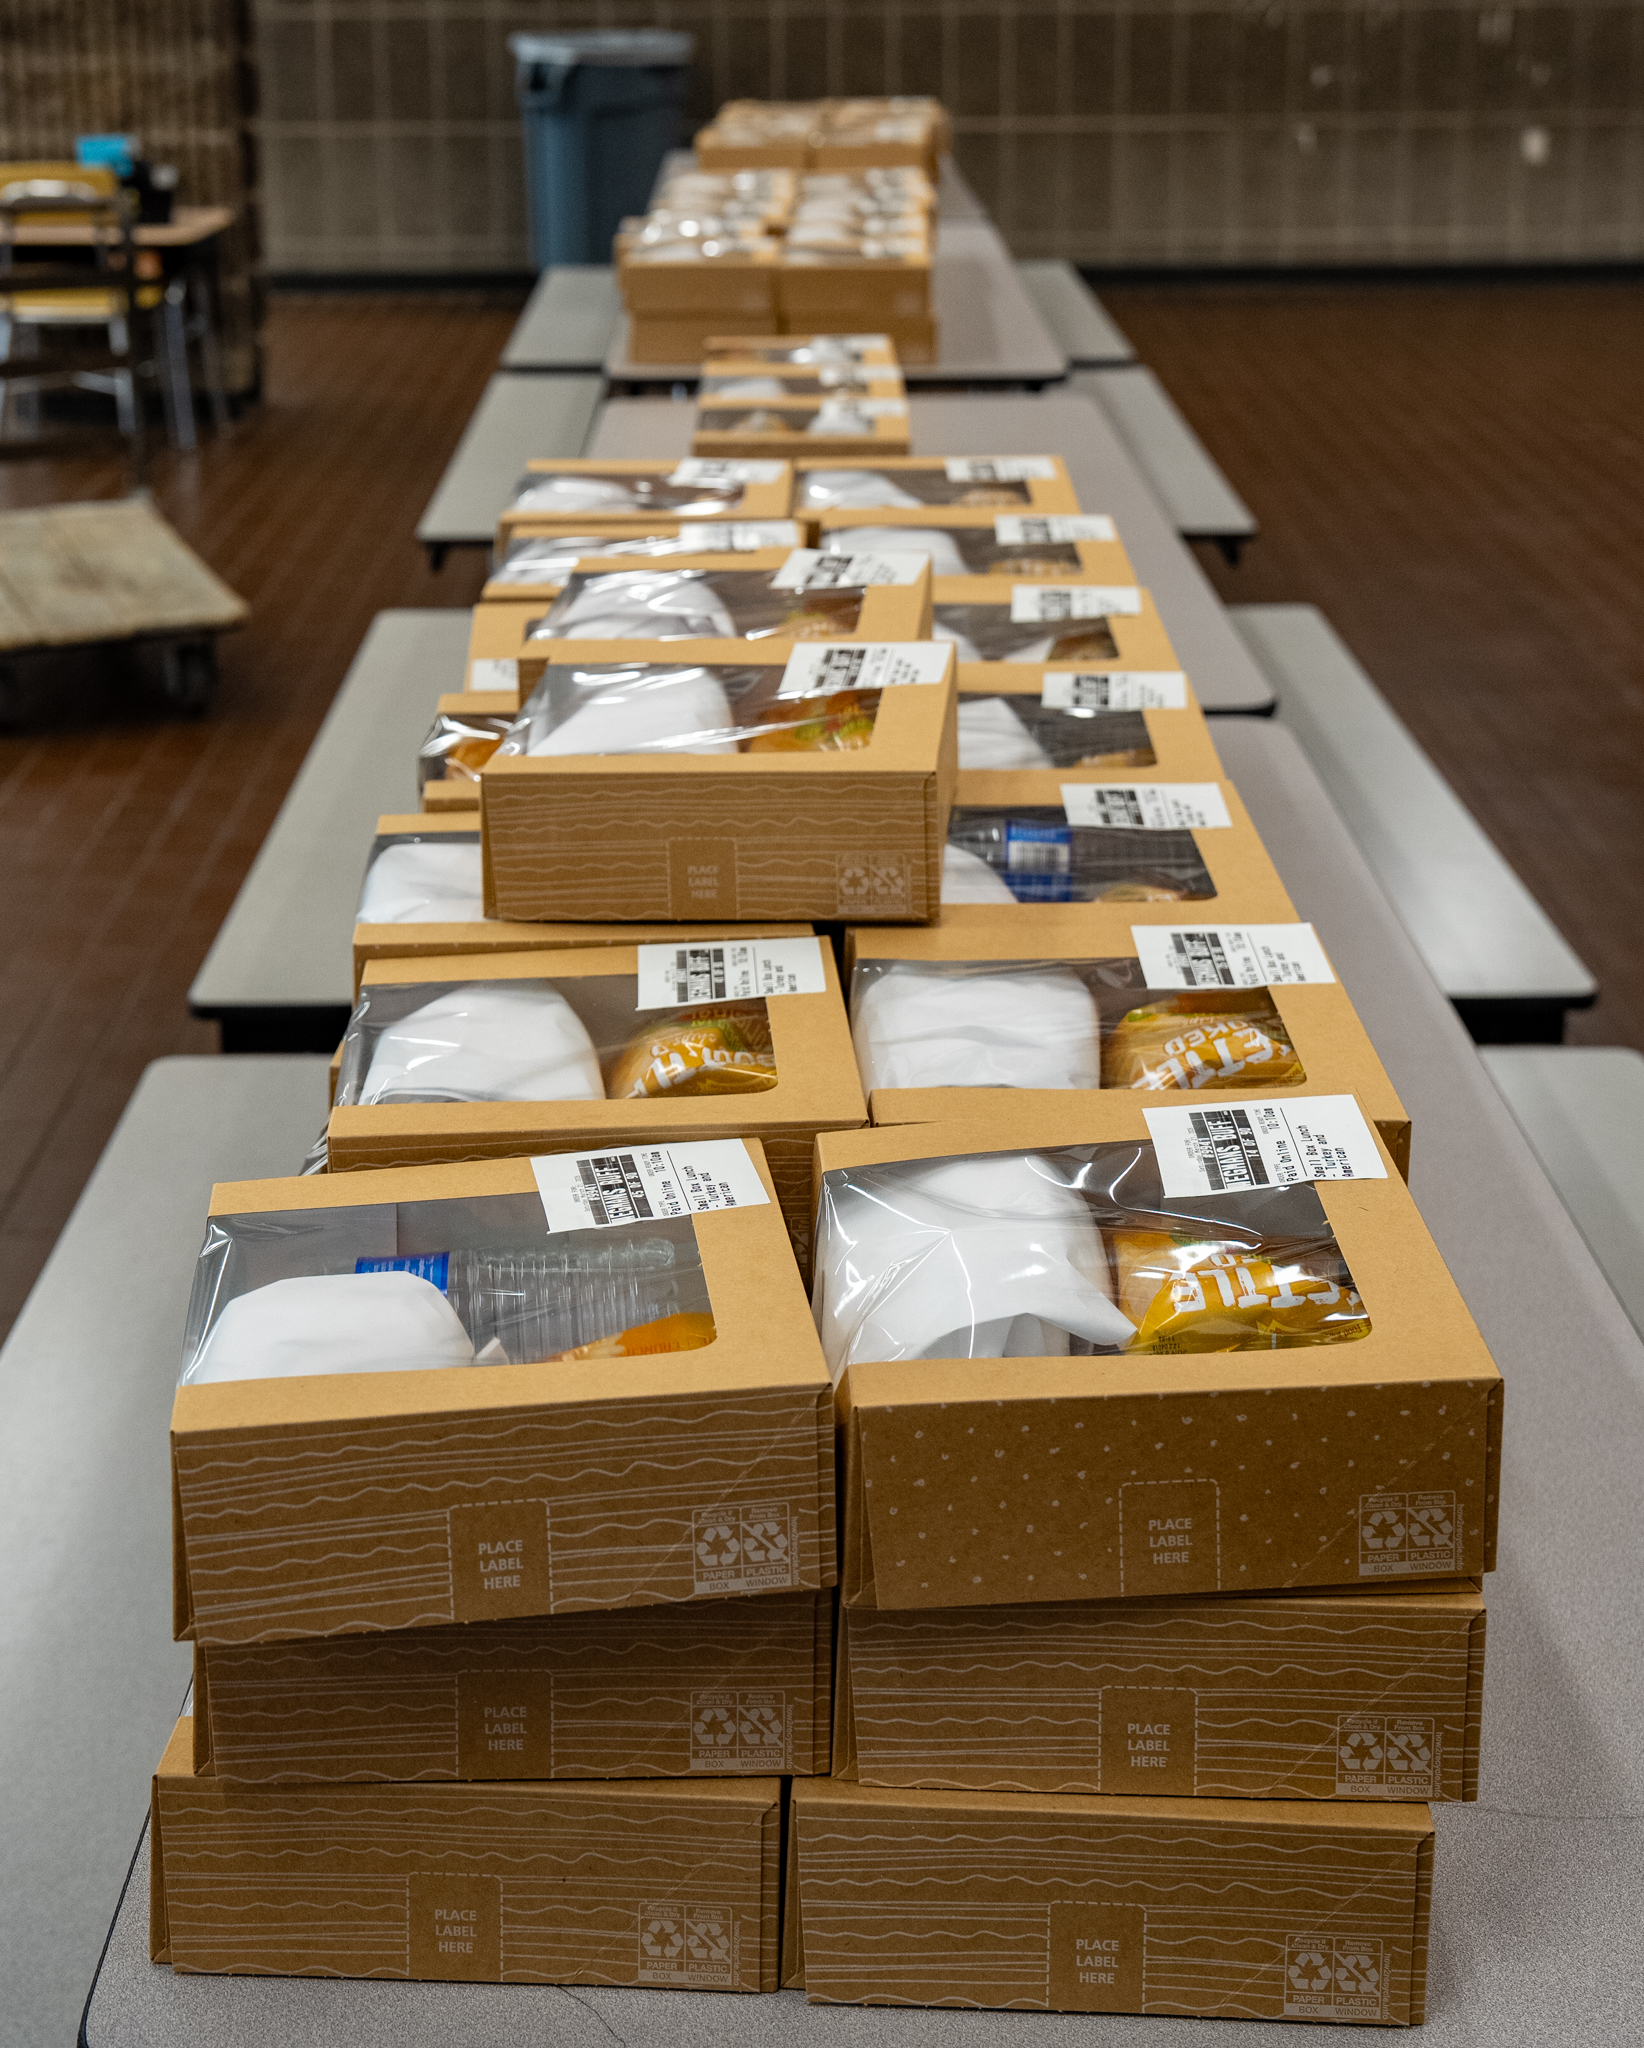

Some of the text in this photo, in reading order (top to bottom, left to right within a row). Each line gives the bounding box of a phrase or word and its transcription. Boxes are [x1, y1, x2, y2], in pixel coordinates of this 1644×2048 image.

[1263, 1108, 1280, 1129] 10:10am
[1207, 1121, 1237, 1140] BUFF
[1242, 1138, 1255, 1146] OF
[1313, 1135, 1327, 1144] and
[1296, 1125, 1326, 1177] Small Box Lunch
[1276, 1140, 1299, 1181] Paid Online
[1321, 1148, 1337, 1170] Turkey
[1335, 1148, 1354, 1177] American
[594, 1167, 623, 1185] BUFF
[698, 1172, 712, 1181] and
[661, 1181, 676, 1200] Online
[682, 1166, 709, 1210] Small Box Lunch
[705, 1185, 720, 1202] Turkey
[719, 1182, 737, 1206] American
[667, 1201, 682, 1215] Paid
[1148, 1518, 1192, 1532] PLACE
[478, 1539, 524, 1555] PLACE
[1149, 1534, 1192, 1548] LABEL
[1153, 1550, 1189, 1564] HERE
[1368, 1554, 1399, 1562] PAPER
[1411, 1551, 1450, 1560] PLASTIC
[479, 1557, 524, 1572] LABEL
[747, 1566, 786, 1576] PLASTIC
[1410, 1562, 1451, 1570] WINDOW
[483, 1574, 522, 1589] HERE
[703, 1570, 735, 1580] PAPER
[709, 1582, 730, 1590] BOX
[746, 1578, 787, 1587] WINDOW
[484, 1705, 527, 1719] PLACE
[485, 1722, 527, 1735] LABEL
[1127, 1723, 1170, 1737] PLACE
[488, 1737, 524, 1750] HERE
[1128, 1738, 1170, 1752] LABEL
[1130, 1755, 1167, 1768] HERE
[1345, 1775, 1376, 1783] PAPER
[1388, 1776, 1428, 1784] PLASTIC
[435, 1908, 477, 1922] PLACE
[435, 1925, 477, 1938] LABEL
[438, 1940, 474, 1954] HERE
[1076, 1938, 1119, 1952] PLACE
[647, 1962, 678, 1970] PAPER
[689, 1964, 727, 1972] PLASTIC
[1076, 1955, 1119, 1969] LABEL
[688, 1974, 729, 1983] WINDOW
[1080, 1971, 1114, 1985] HERE
[1293, 1995, 1324, 2003] PAPER
[1336, 1997, 1376, 2006] PLASTIC
[1299, 2006, 1318, 2014] BOX
[1335, 2008, 1377, 2016] WINDOW
